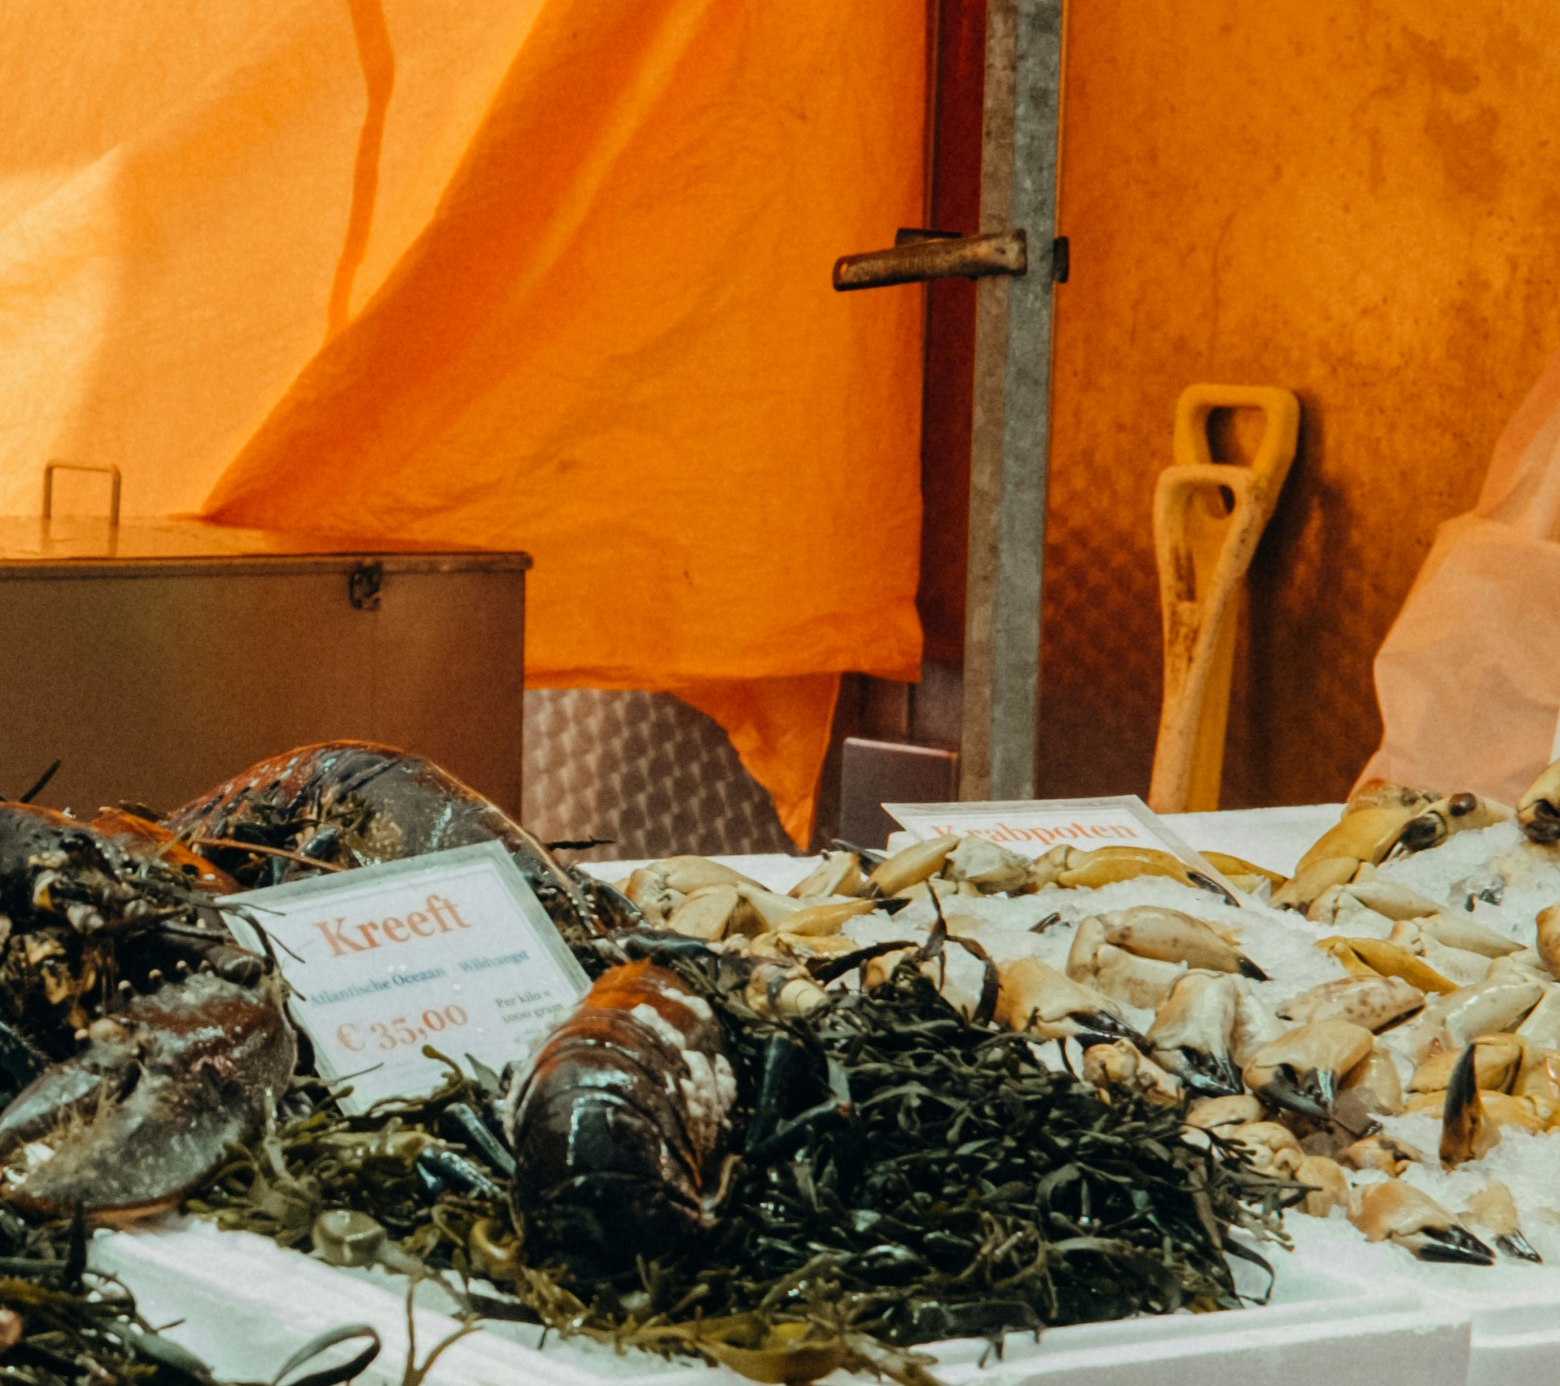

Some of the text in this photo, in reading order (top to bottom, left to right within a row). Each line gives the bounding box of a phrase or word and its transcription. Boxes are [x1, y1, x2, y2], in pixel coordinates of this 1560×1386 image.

[313, 893, 474, 958] Kreeft
[309, 949, 531, 1008] Atlantische Oceaan Wildvangst
[518, 990, 542, 1006] kilo
[336, 1004, 470, 1053] € 35,00
